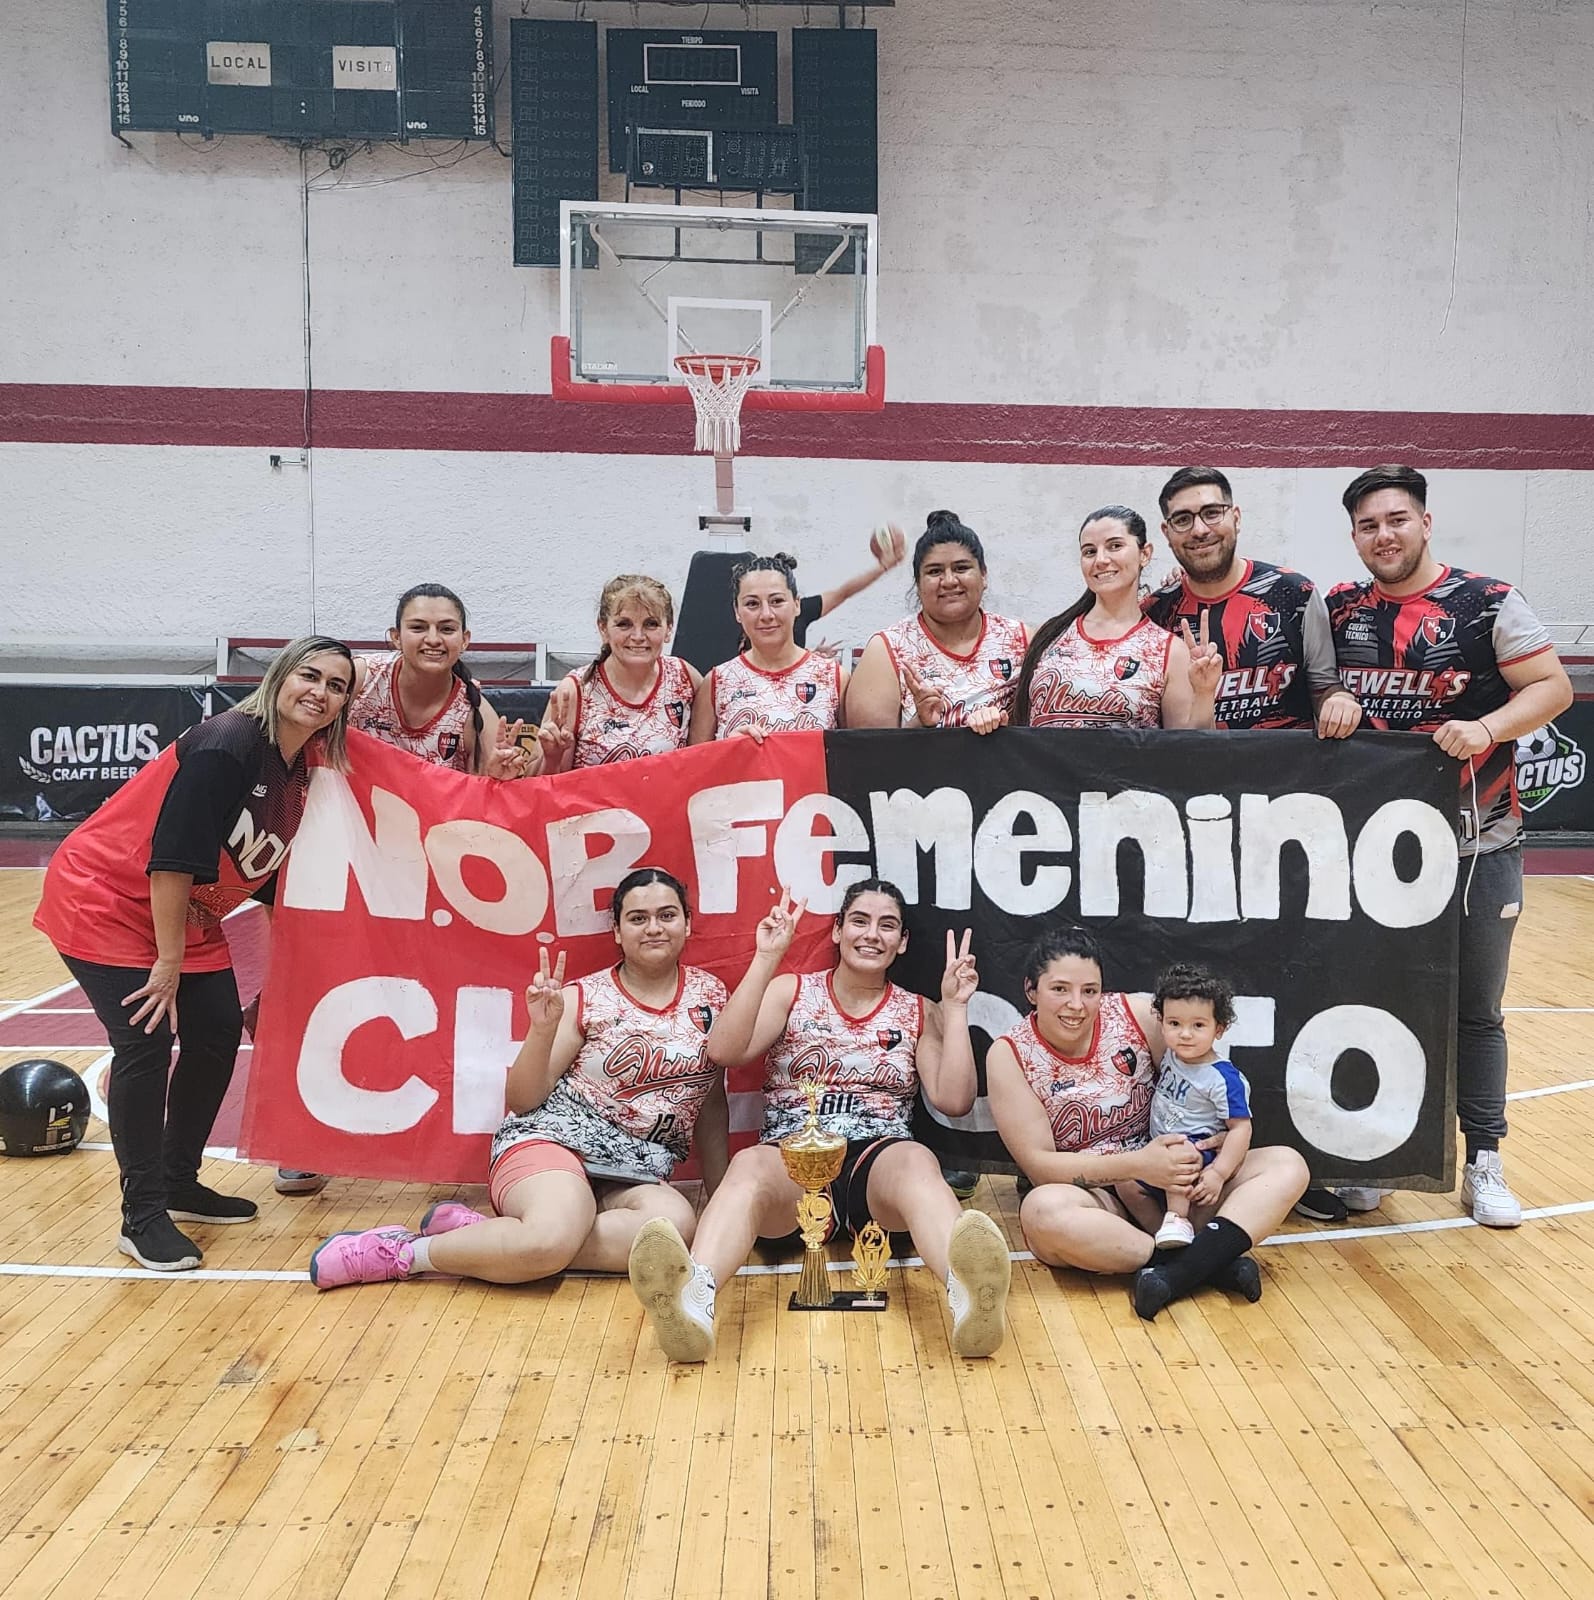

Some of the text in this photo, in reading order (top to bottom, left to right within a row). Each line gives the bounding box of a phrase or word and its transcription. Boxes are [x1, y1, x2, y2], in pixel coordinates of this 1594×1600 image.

[120, 8, 128, 16] 5
[473, 5, 482, 16] 4
[119, 17, 128, 27] 6
[474, 16, 482, 27] 5
[475, 28, 483, 38] 6
[120, 39, 128, 49] 8
[476, 39, 483, 49] 7
[120, 50, 128, 60] 9
[476, 50, 484, 60] 8
[116, 60, 129, 70] 10
[210, 55, 268, 70] LOCAL
[476, 62, 484, 72] 9
[116, 71, 128, 80] 11
[472, 72, 484, 82] 10
[116, 82, 129, 92] 12
[630, 85, 649, 94] LOCAL
[741, 87, 760, 96] VISITA
[116, 92, 130, 103] 13
[472, 93, 485, 103] 12
[117, 104, 130, 114] 14
[472, 104, 486, 114] 13
[117, 114, 130, 124] 15
[178, 114, 200, 123] uno
[472, 115, 486, 124] 14
[406, 121, 428, 130] uno
[473, 126, 486, 136] 15
[1361, 698, 1443, 709] SKETBALL
[30, 723, 159, 765] CACTUS
[52, 766, 138, 781] CRAFT BEER
[1517, 754, 1581, 791] CTUS
[687, 780, 1458, 930] Femenino
